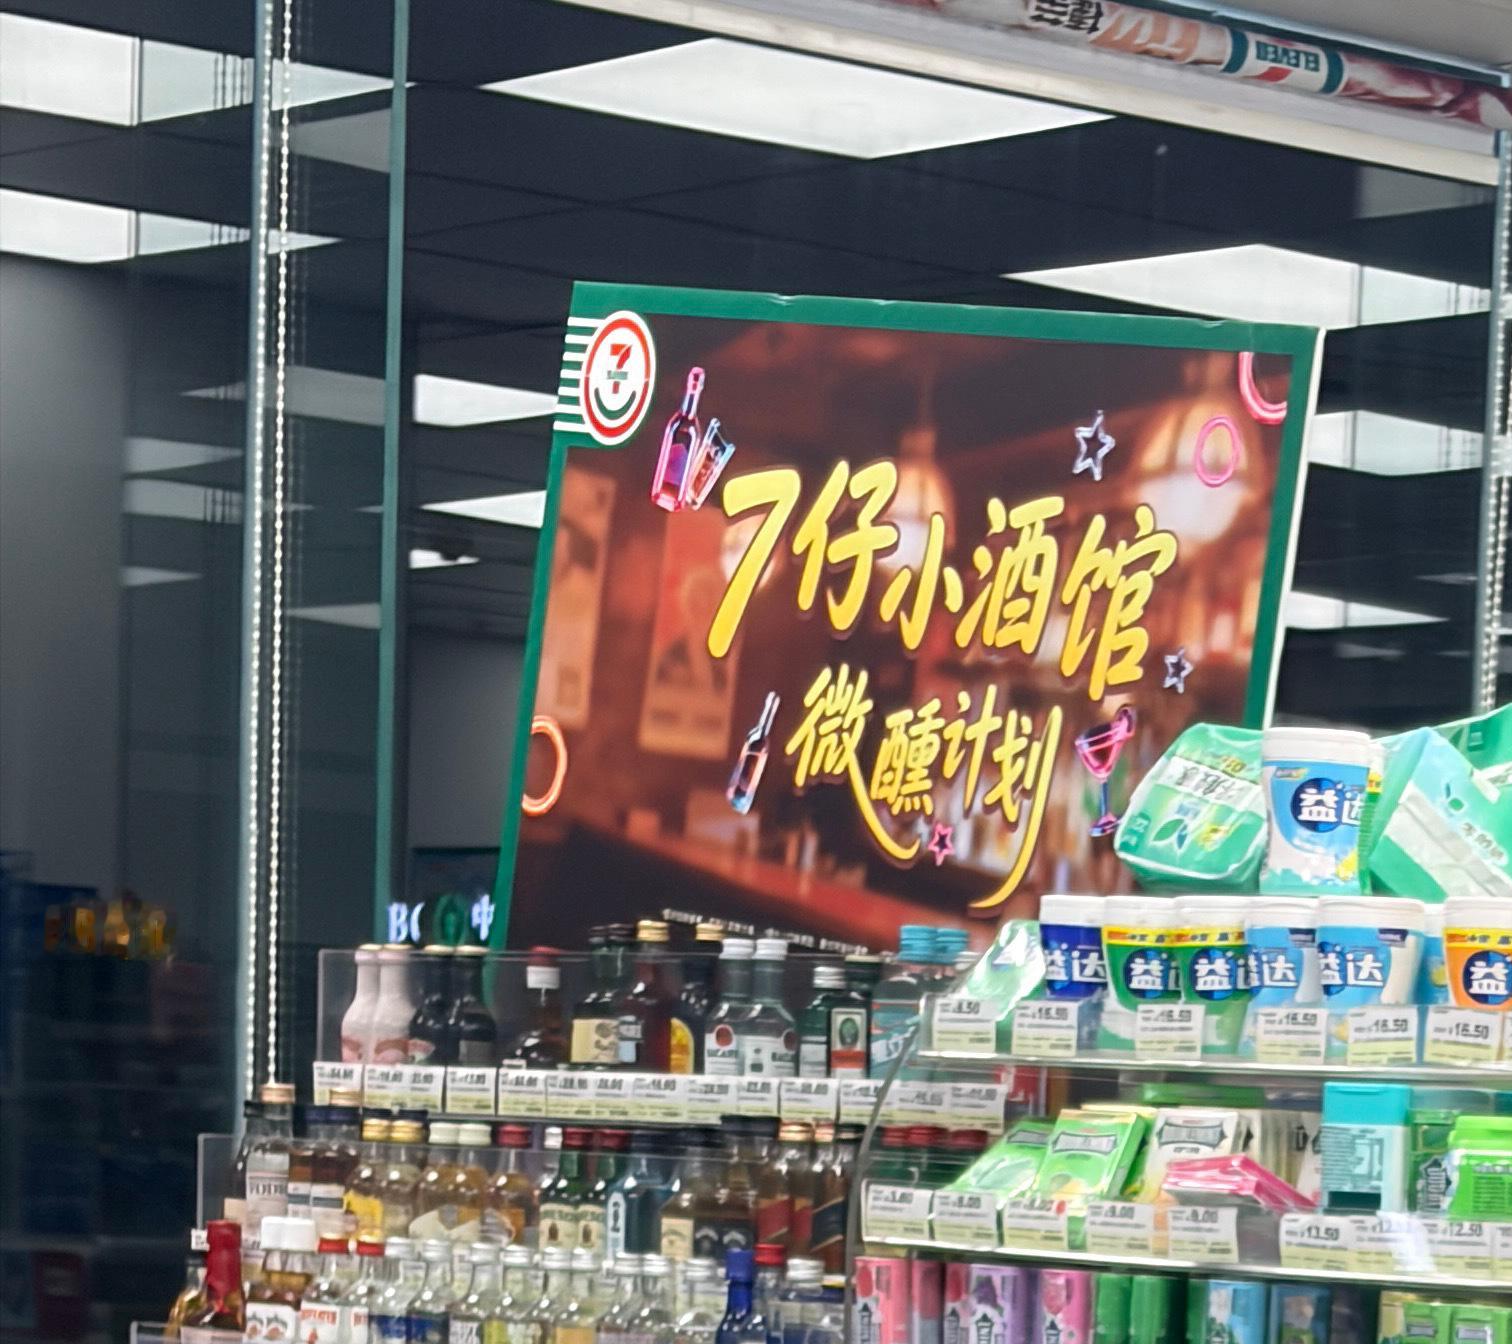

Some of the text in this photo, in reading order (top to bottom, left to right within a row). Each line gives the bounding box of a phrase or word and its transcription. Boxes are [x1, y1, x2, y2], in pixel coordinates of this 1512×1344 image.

[707, 460, 1178, 702] 7仔小酒馆
[786, 663, 1063, 910] 微醺计划
